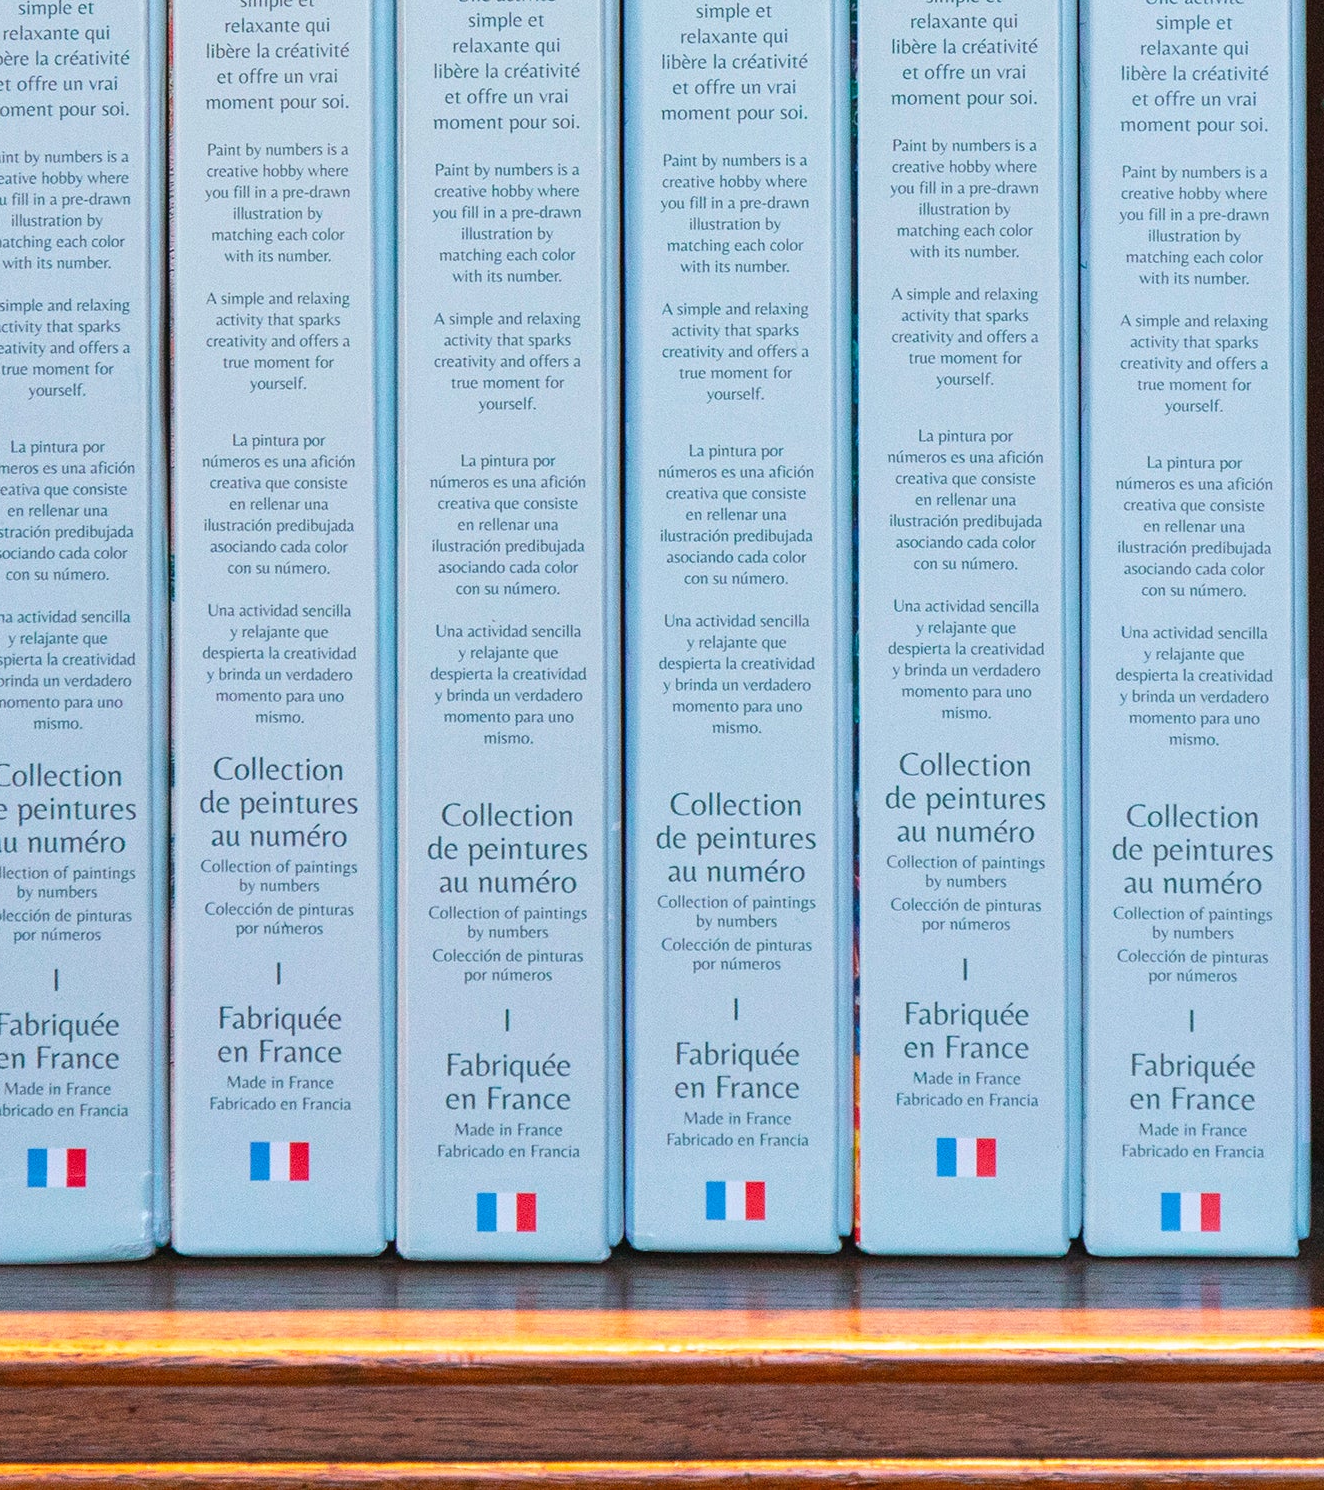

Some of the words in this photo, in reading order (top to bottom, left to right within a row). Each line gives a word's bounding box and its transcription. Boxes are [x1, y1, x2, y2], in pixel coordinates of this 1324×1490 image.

[662, 153, 697, 167] Paint
[701, 153, 717, 171] by
[721, 153, 782, 168] numbers
[785, 156, 796, 167] is
[799, 156, 808, 167] a
[889, 513, 959, 528] ilustración
[962, 514, 1043, 532] predibujada
[1125, 802, 1259, 830] Collection
[1111, 835, 1144, 862] de
[1152, 837, 1274, 868] peintures
[1123, 875, 1154, 895] au
[1162, 870, 1263, 896] numéro
[1130, 1052, 1256, 1085] Fabriquée
[1128, 1092, 1161, 1111] en
[1171, 1085, 1256, 1112] France
[1138, 1122, 1180, 1137] Made
[1183, 1123, 1197, 1137] in
[1201, 1122, 1248, 1138] France
